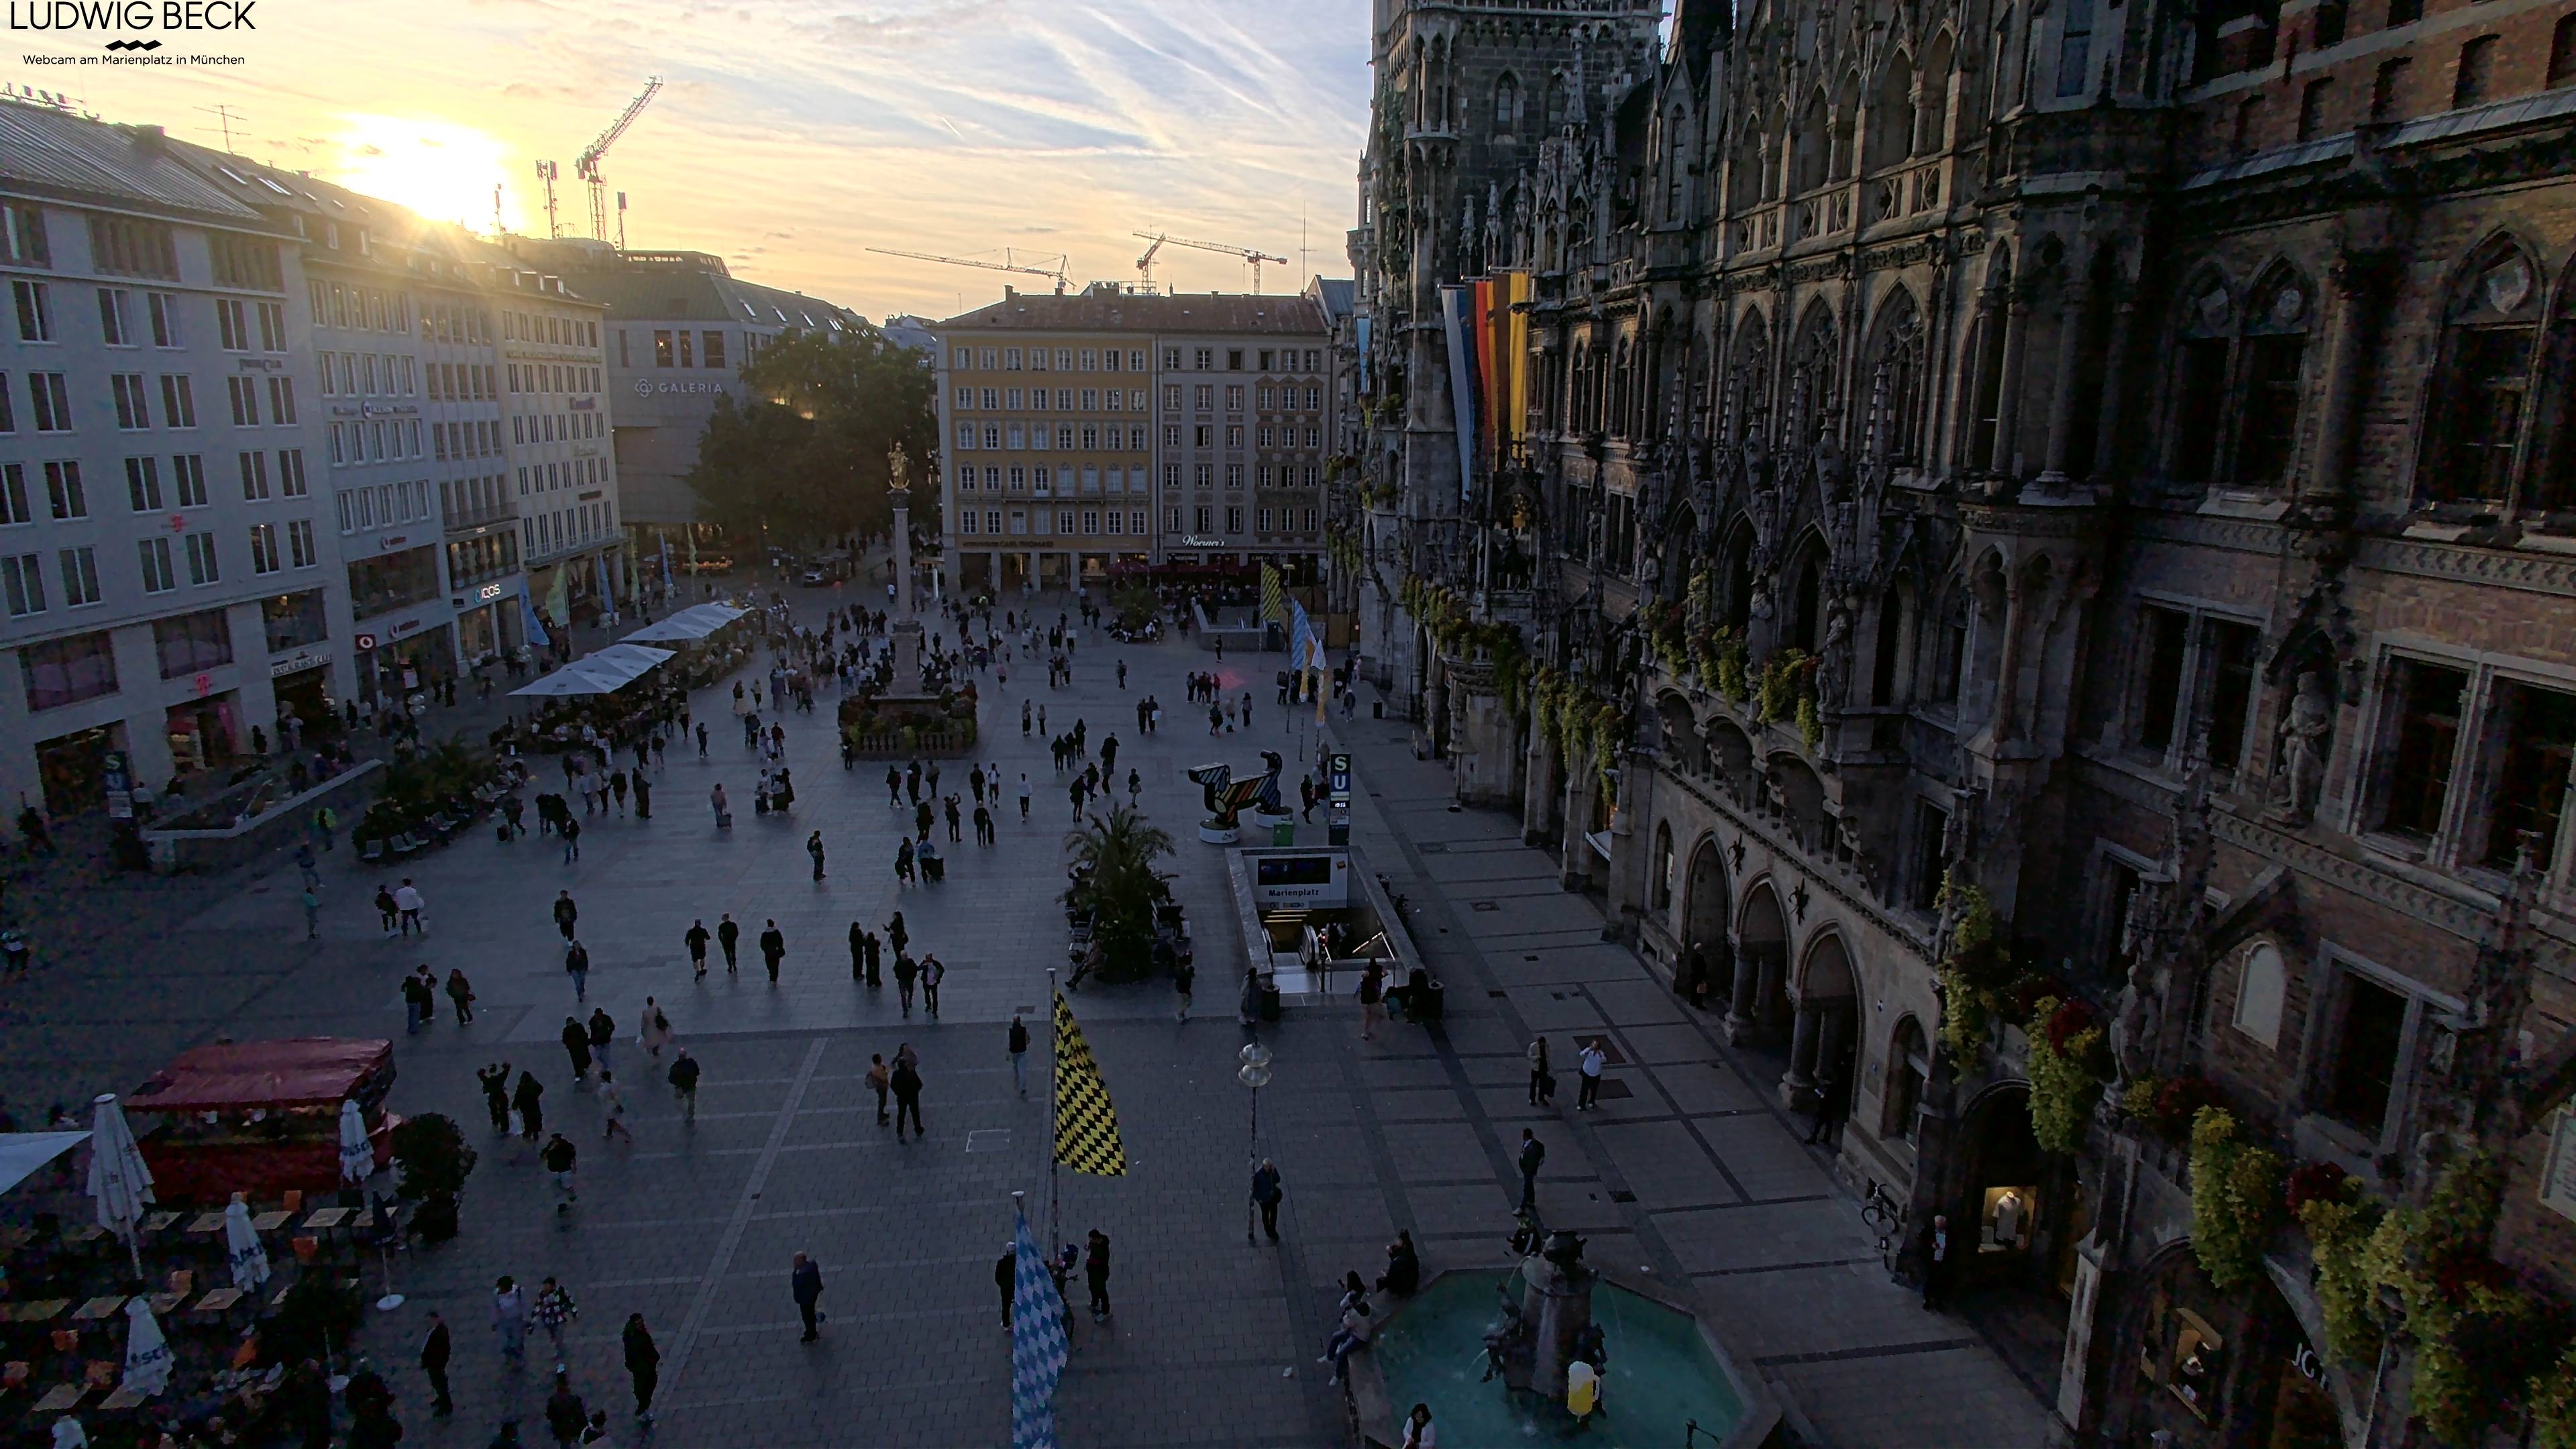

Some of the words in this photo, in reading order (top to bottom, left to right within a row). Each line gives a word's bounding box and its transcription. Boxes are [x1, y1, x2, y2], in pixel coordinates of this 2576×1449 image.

[659, 383, 723, 393] GALERIA
[1182, 535, 1225, 547] Woerner's
[481, 584, 500, 599] IQOS
[1334, 756, 1347, 771] S
[1334, 775, 1346, 790] U
[1269, 889, 1320, 898] Marienplatz
